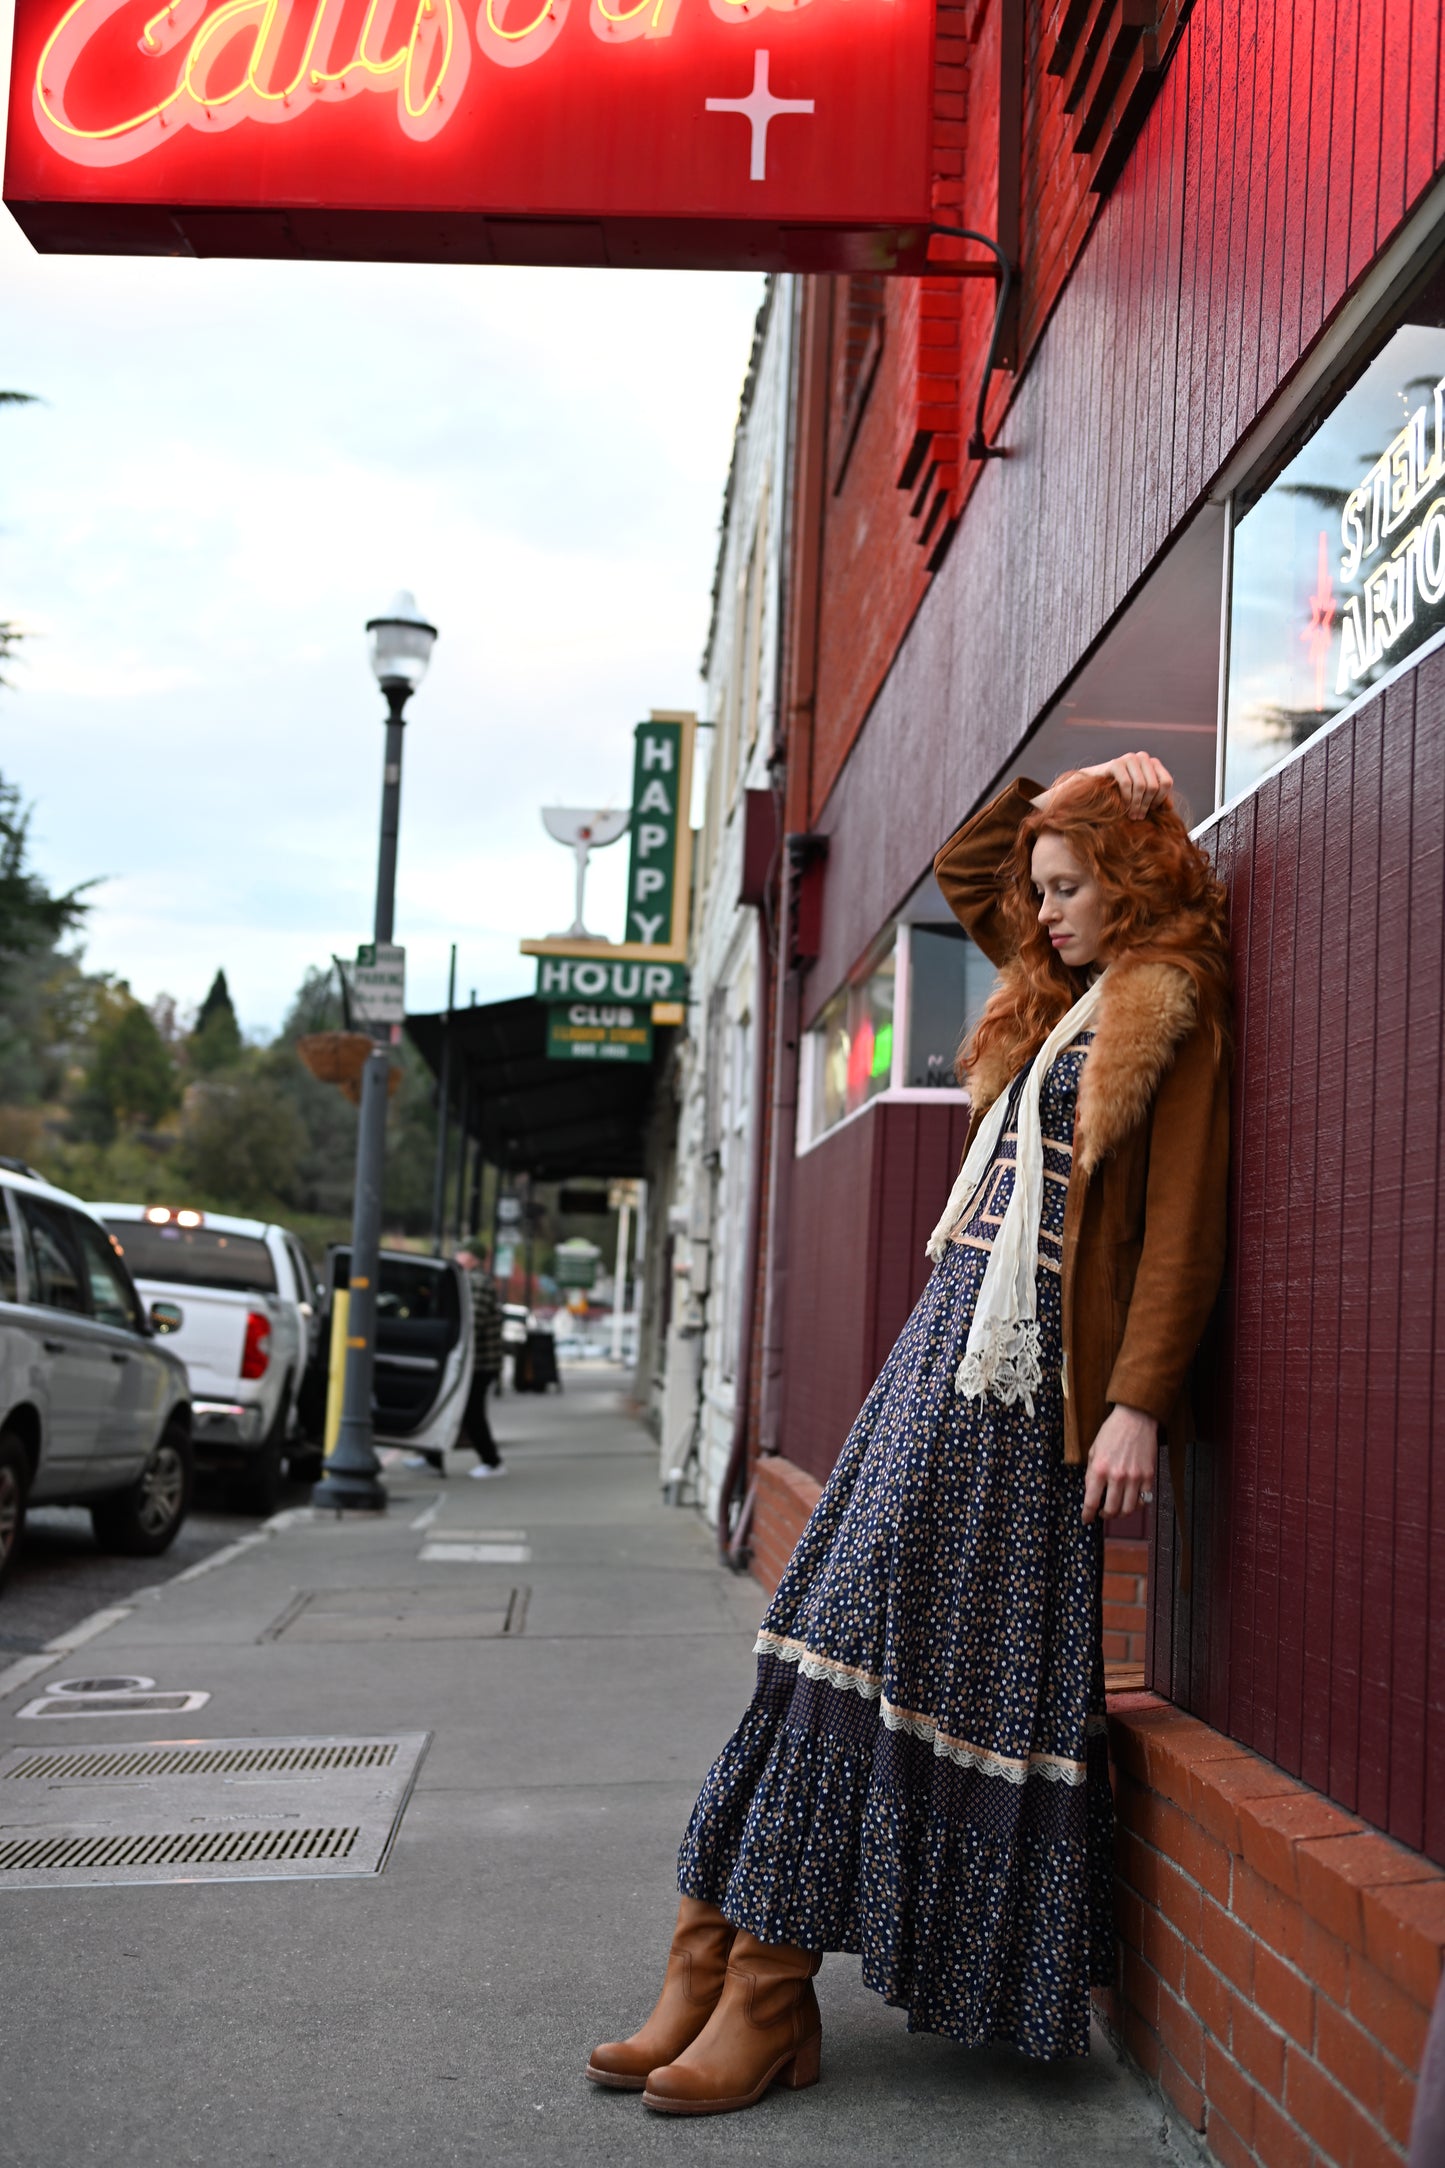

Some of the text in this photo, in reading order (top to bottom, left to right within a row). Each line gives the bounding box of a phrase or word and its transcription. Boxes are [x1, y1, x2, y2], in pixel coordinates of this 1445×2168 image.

[32, 0, 822, 167] Califo
[631, 736, 674, 945] HAPPY
[543, 961, 674, 998] HOUR
[568, 1004, 634, 1027] CLUB
